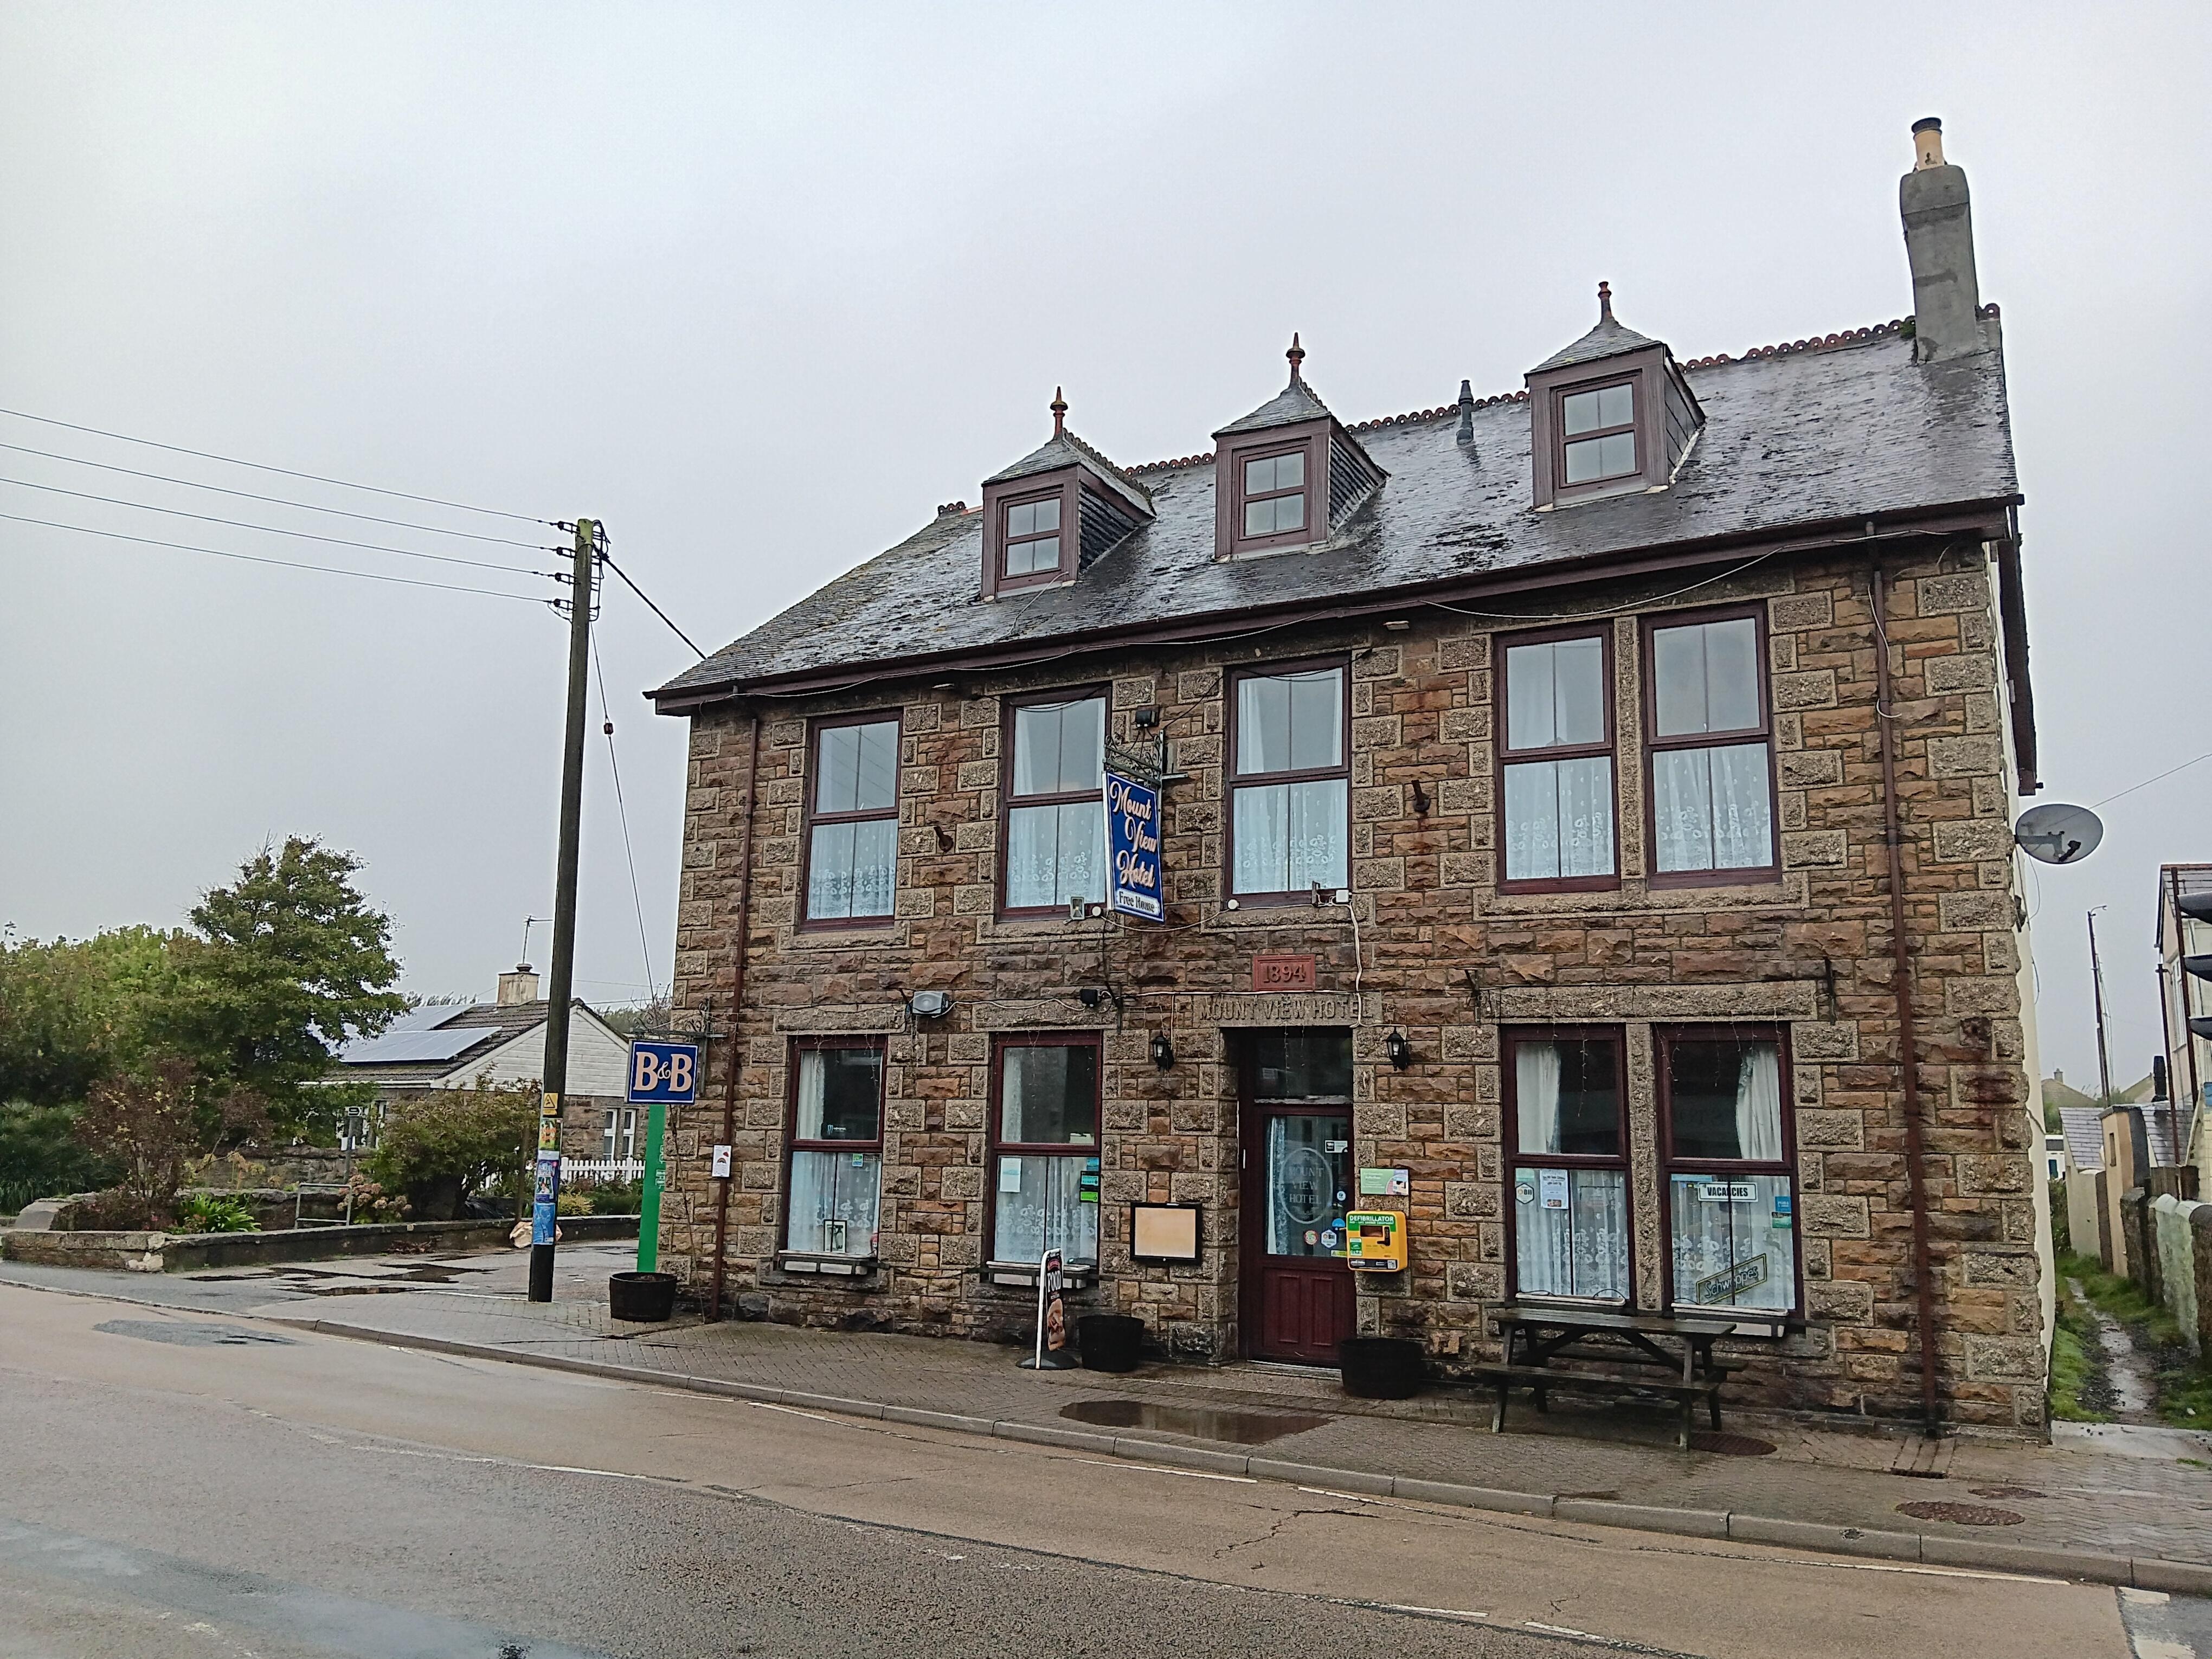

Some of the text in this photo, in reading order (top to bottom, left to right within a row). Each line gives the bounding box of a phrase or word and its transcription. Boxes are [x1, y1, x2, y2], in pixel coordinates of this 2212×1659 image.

[1109, 781, 1152, 820] Mount
[1124, 816, 1158, 853] View
[1116, 850, 1155, 889] Hotel
[1119, 891, 1155, 912] Free House
[1263, 964, 1307, 983] 1894
[1199, 1000, 1374, 1020] MOUNT VIEW HOTEL
[633, 1051, 692, 1092] B&B
[1292, 1180, 1319, 1190] VIEW
[1289, 1193, 1322, 1204] HOTEL
[1047, 1270, 1062, 1293] FOOD
